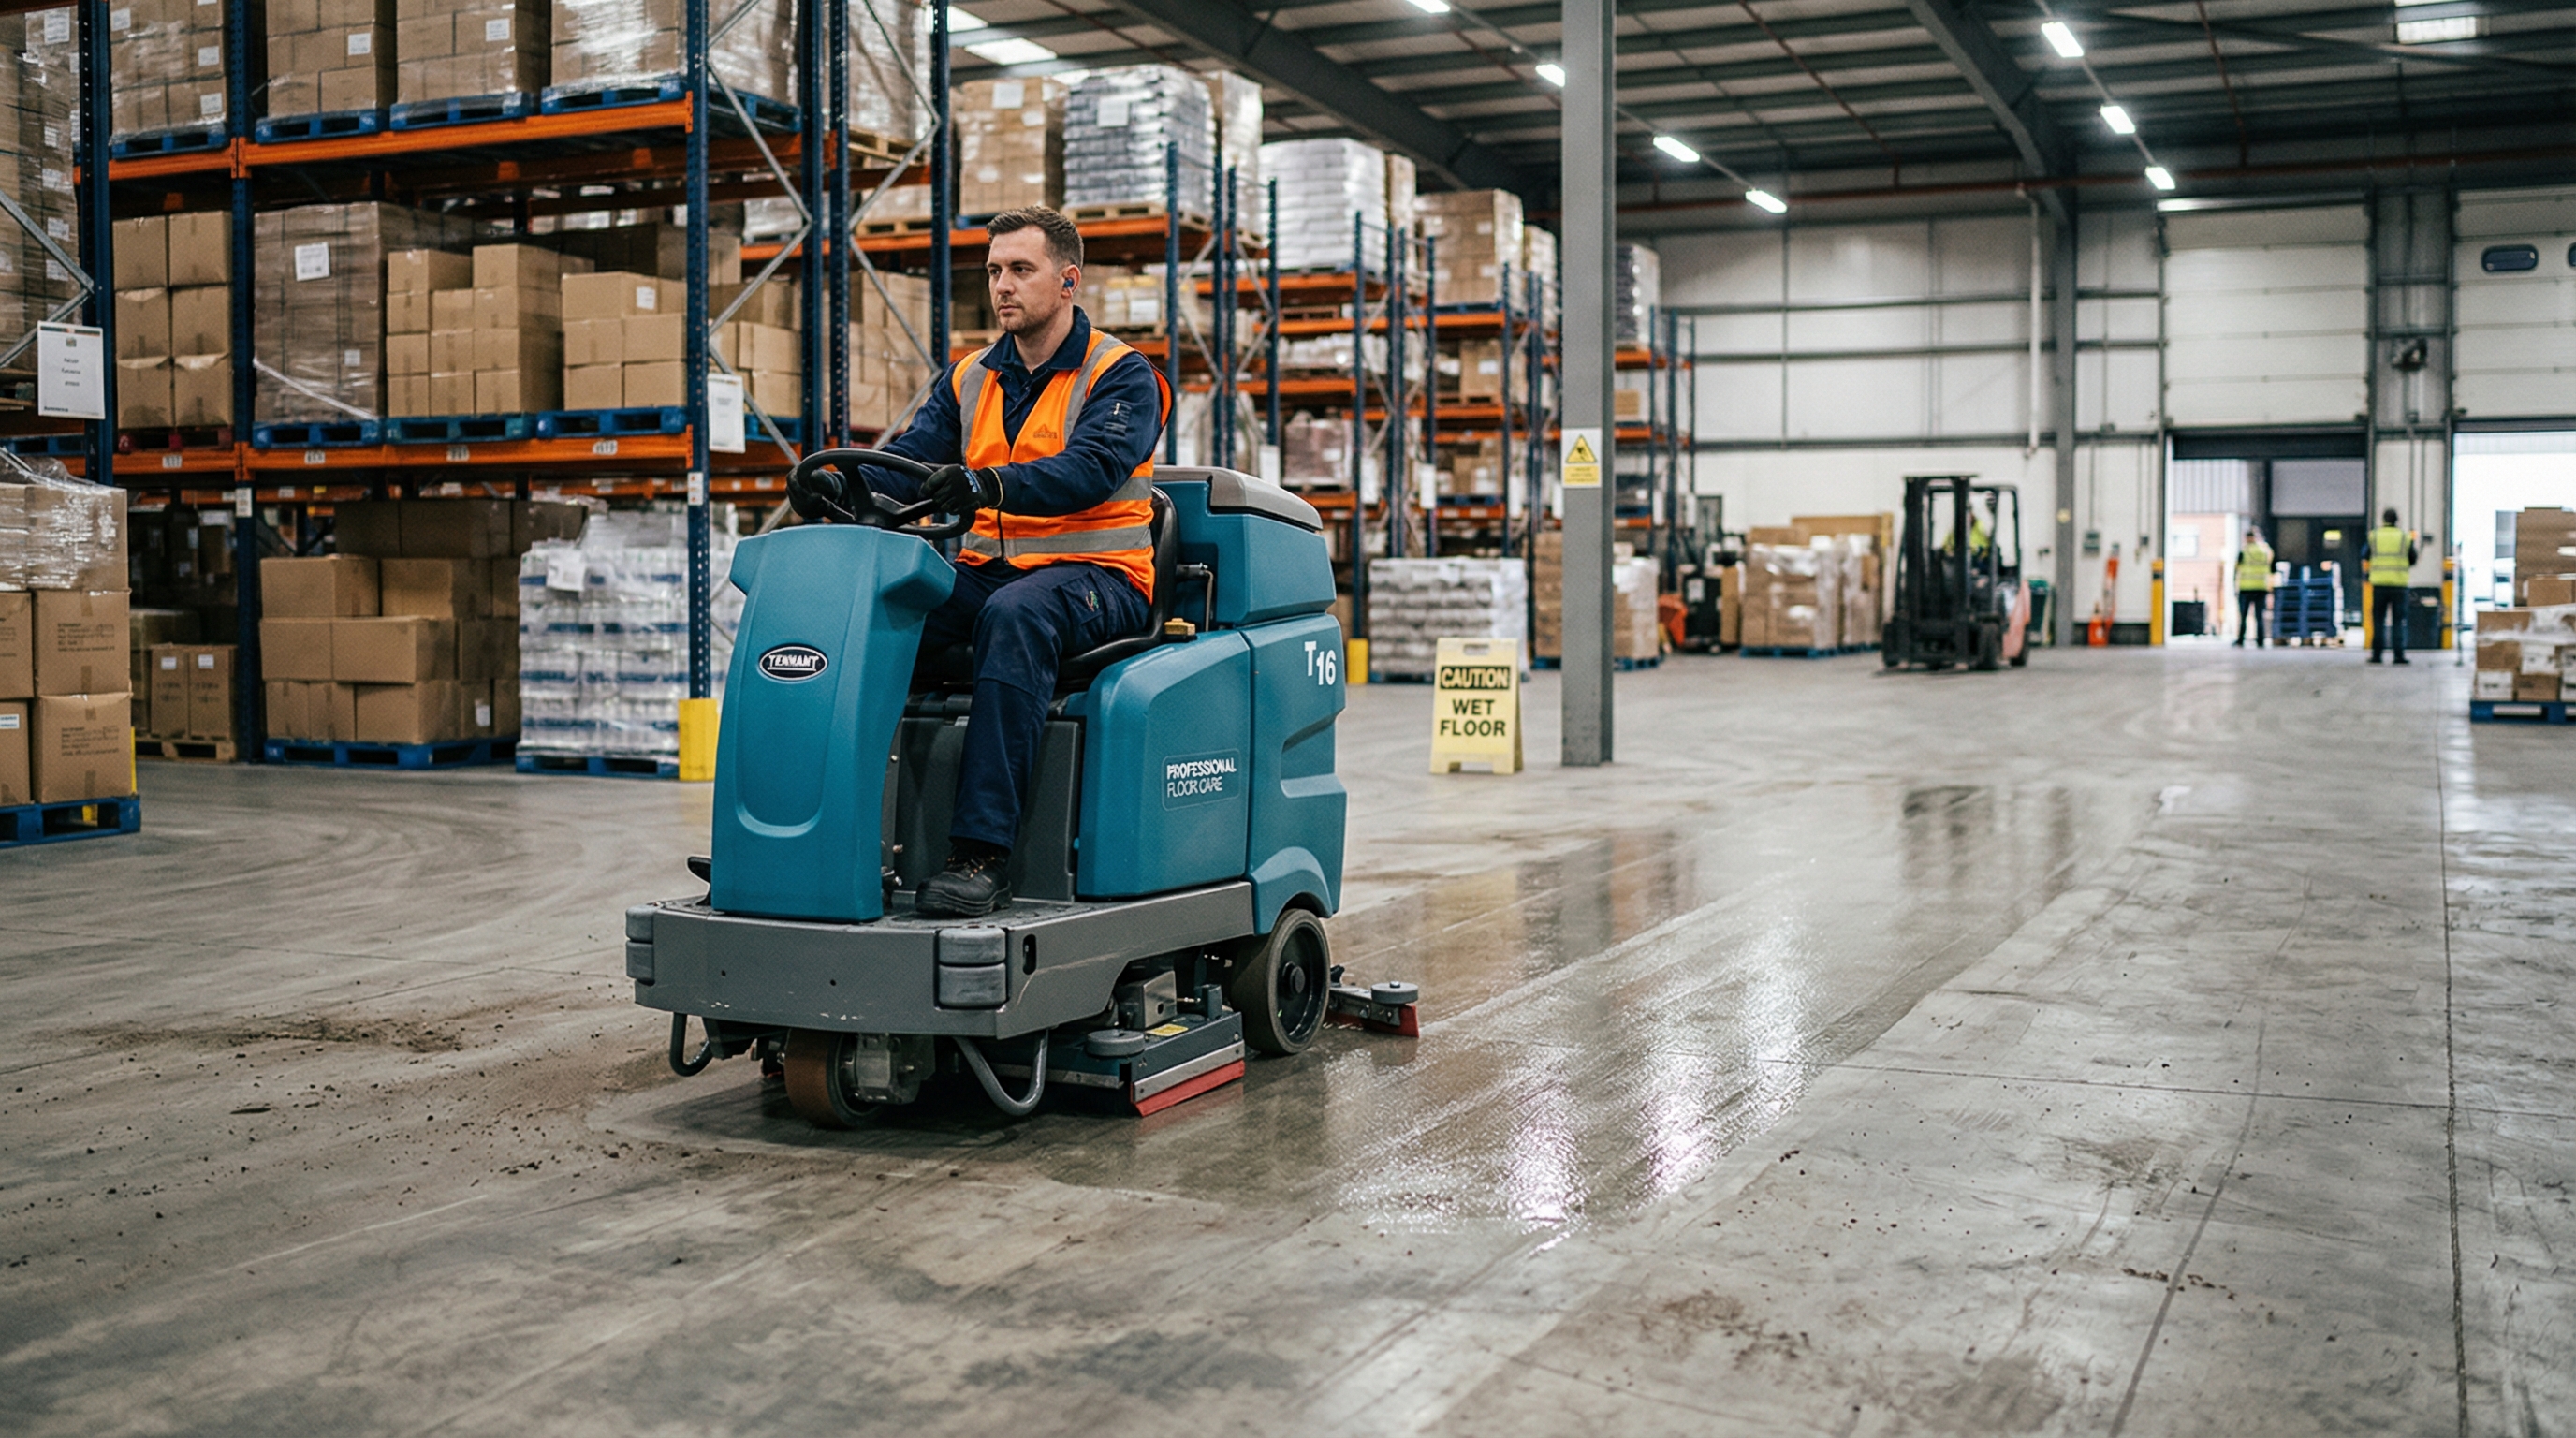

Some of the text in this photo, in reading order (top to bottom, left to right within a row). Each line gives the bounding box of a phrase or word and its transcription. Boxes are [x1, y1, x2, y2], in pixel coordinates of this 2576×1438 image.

[768, 654, 819, 671] TENNANT
[1442, 668, 1509, 688] CAUTION
[1453, 698, 1495, 715] WET
[1440, 719, 1505, 736] FLOOR
[1166, 757, 1237, 780] PROFESSIONAL
[1166, 776, 1223, 798] FLOOR CARE
